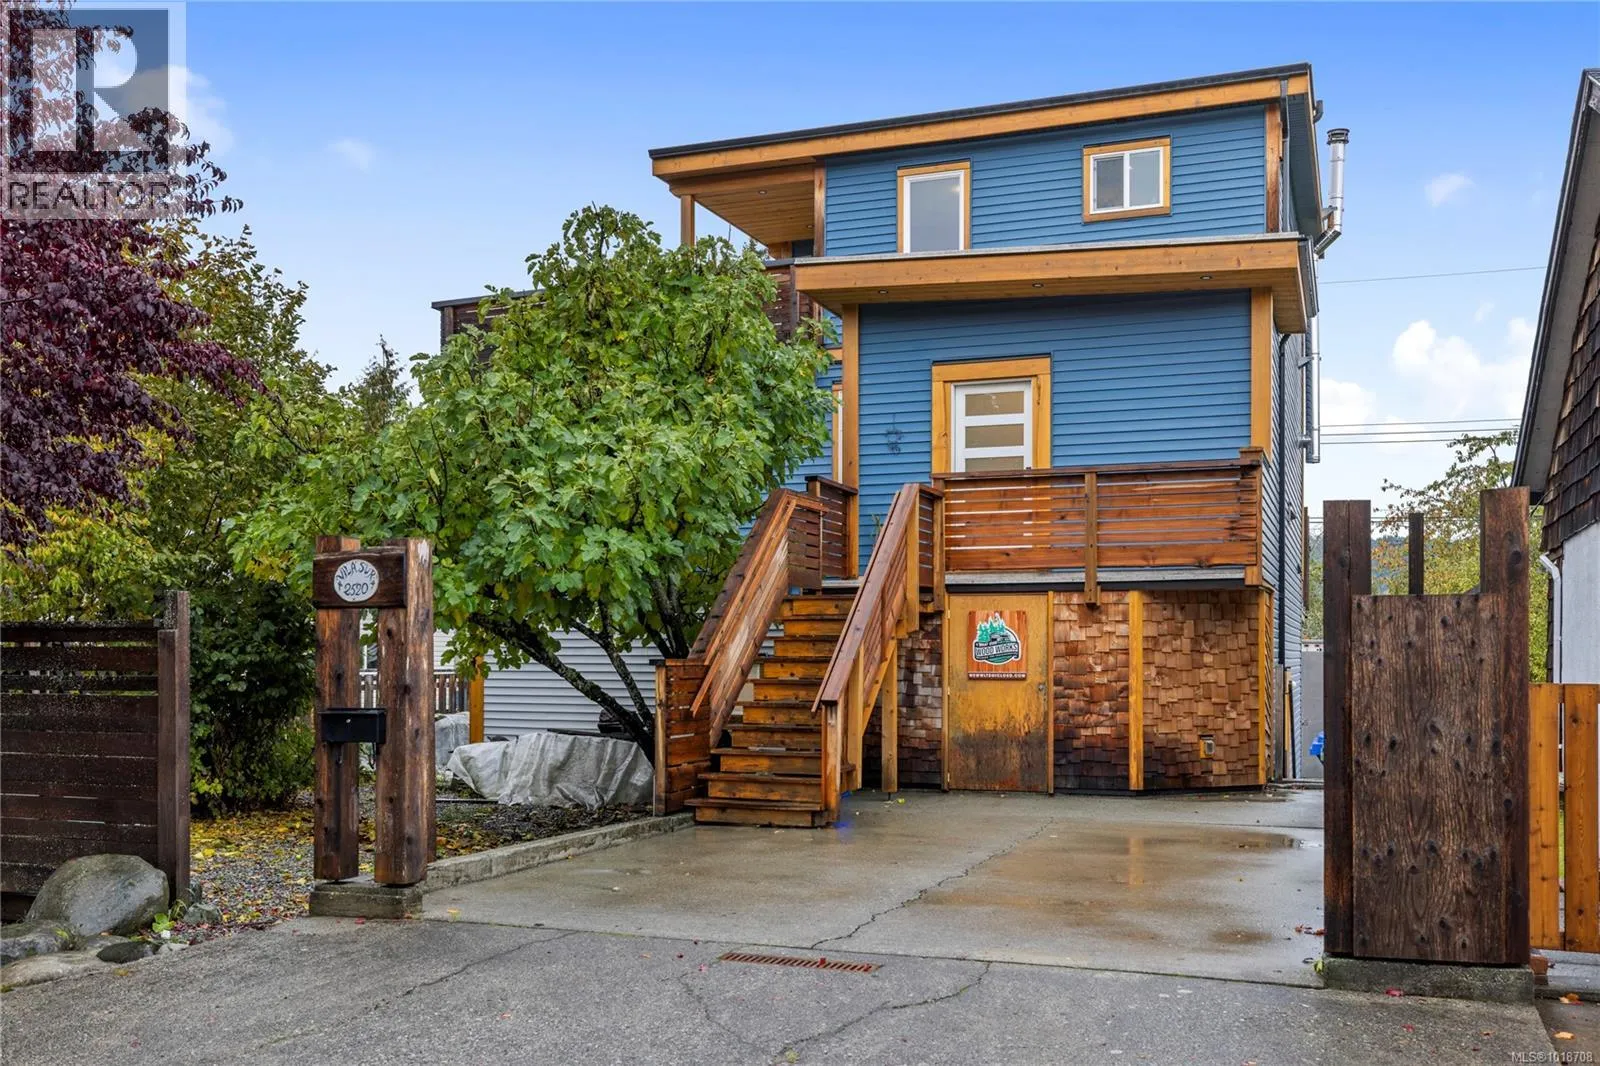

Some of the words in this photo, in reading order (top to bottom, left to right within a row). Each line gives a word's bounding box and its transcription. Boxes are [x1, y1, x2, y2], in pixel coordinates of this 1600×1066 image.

[344, 582, 369, 596] 2520
[975, 646, 994, 656] WOOD
[995, 643, 1019, 654] WORKS
